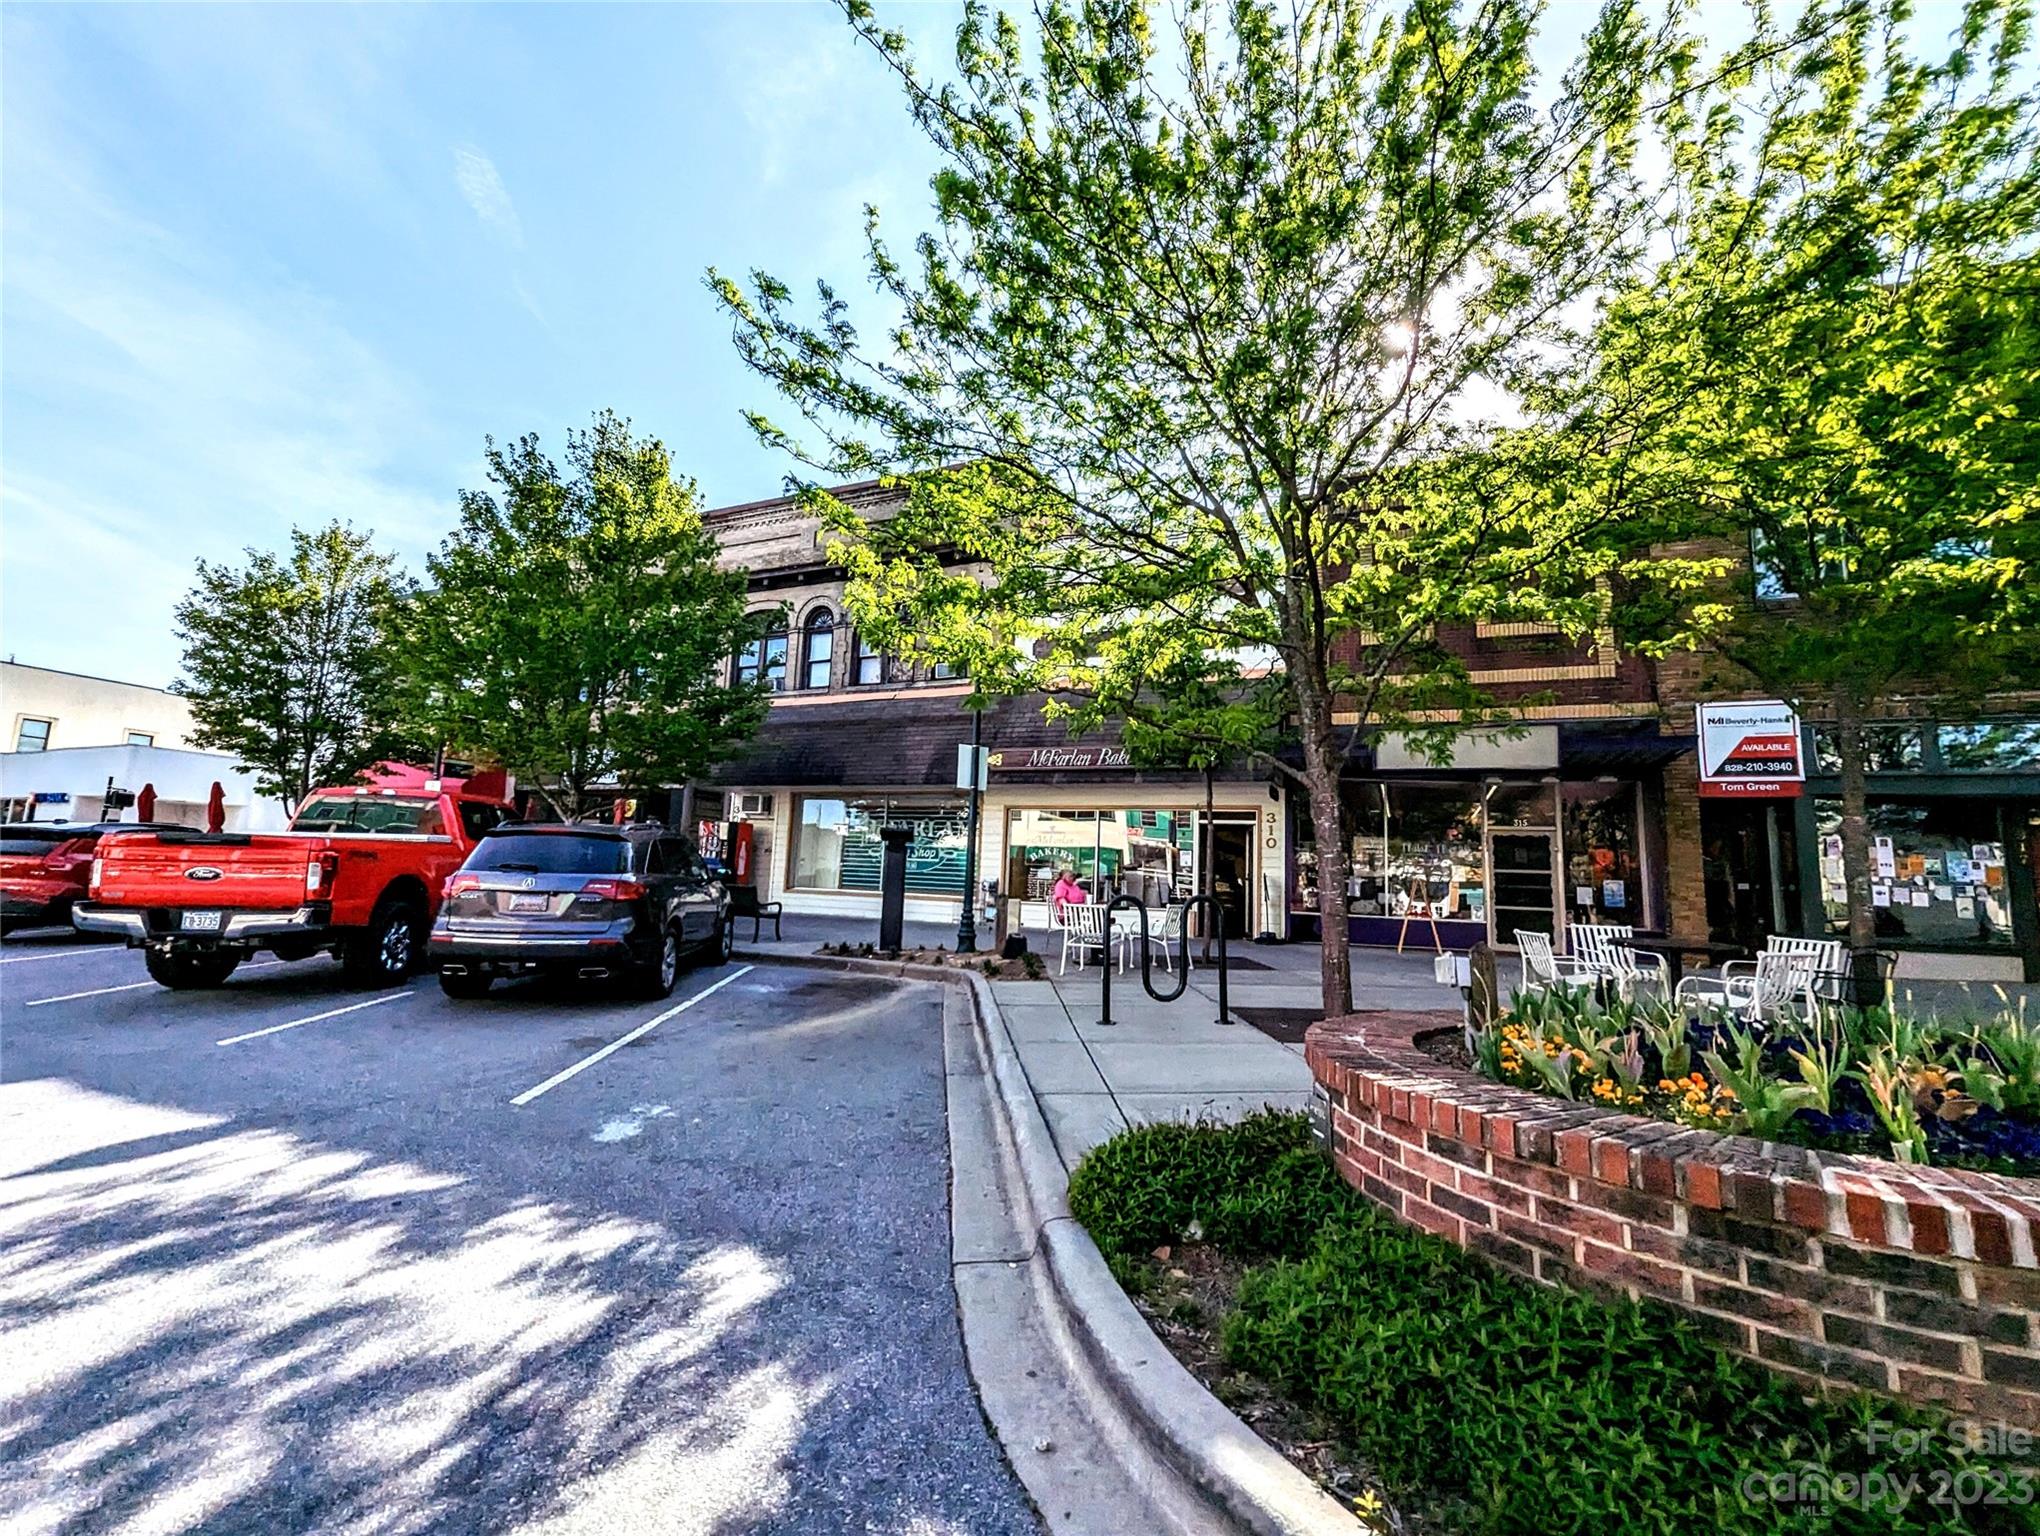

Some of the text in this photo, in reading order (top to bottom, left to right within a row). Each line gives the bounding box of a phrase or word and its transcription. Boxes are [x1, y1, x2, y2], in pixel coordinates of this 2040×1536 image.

[1725, 716, 1790, 725] Beverly-Hank
[1741, 743, 1791, 752] AVAILABLE
[1026, 748, 1092, 767] McFarlan
[1724, 762, 1793, 772] 828-210-3940
[1720, 782, 1780, 791] Tom Green
[1513, 818, 1528, 827] 315
[1266, 812, 1277, 849] 310
[1029, 847, 1075, 862] BAKERY
